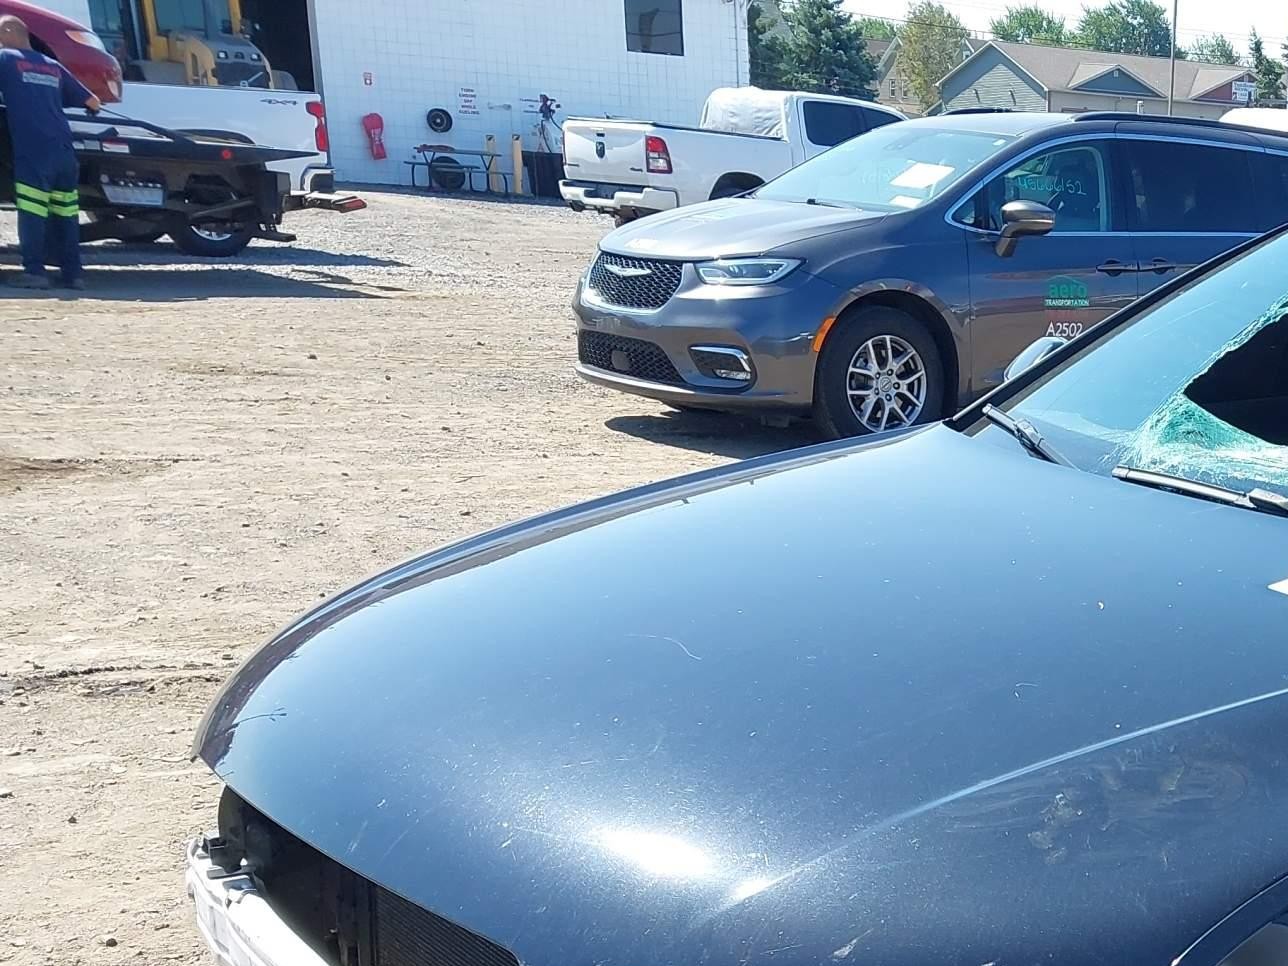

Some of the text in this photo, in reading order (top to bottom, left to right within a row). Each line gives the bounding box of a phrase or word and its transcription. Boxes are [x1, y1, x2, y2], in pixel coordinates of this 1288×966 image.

[1049, 284, 1088, 298] aero
[1044, 298, 1090, 307] TRANSPORTATION
[1045, 321, 1083, 337] A2502
